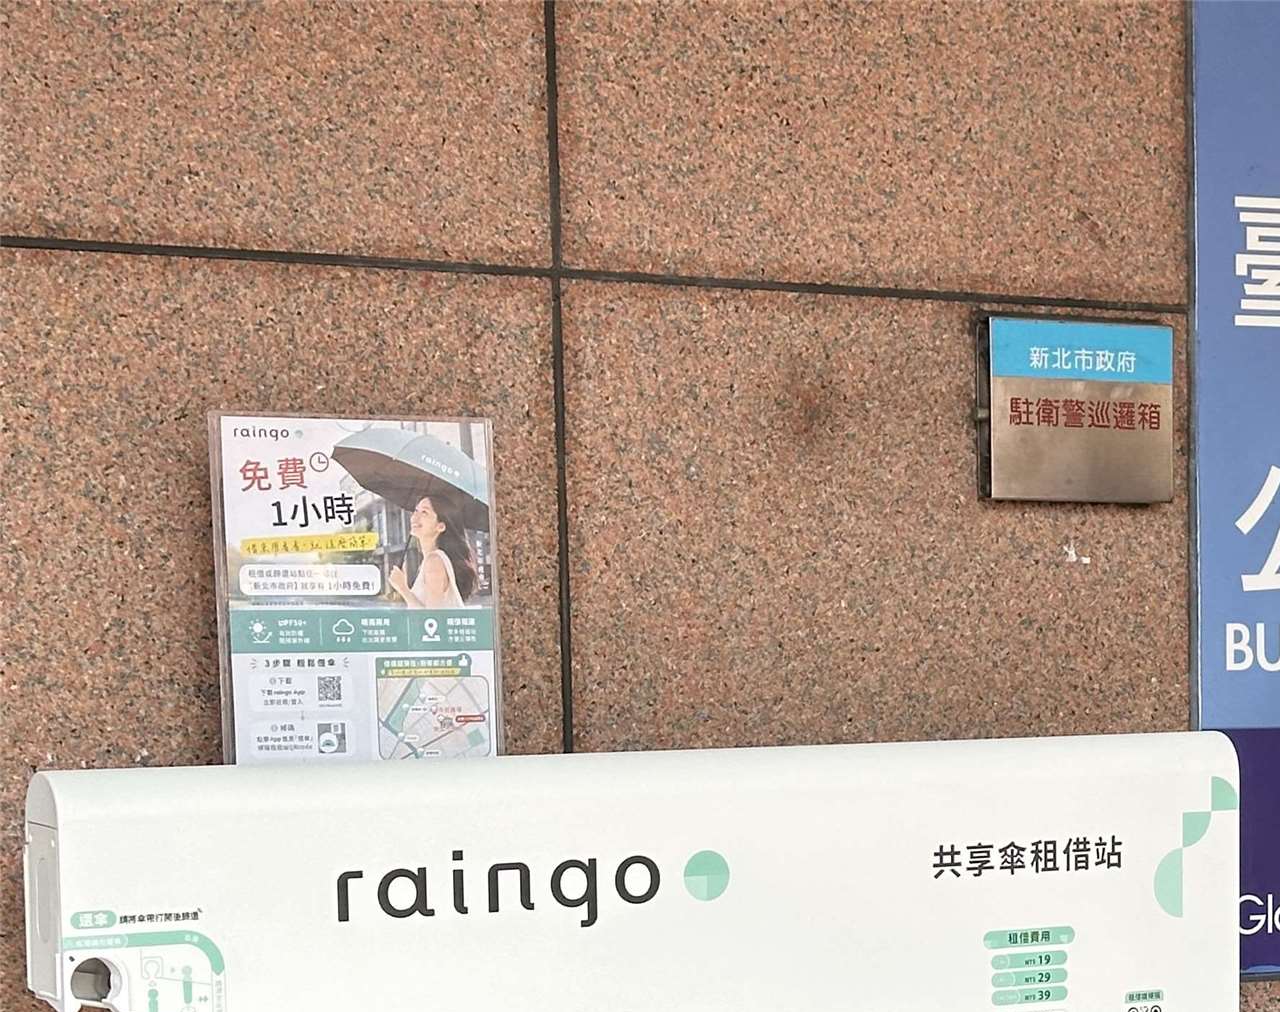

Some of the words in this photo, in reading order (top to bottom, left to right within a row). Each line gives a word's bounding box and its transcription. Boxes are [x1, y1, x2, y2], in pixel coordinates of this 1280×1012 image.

[1029, 347, 1136, 373] 新北市政府
[1009, 397, 1161, 431] 駐衛警巡邏箱
[233, 426, 290, 441] raingo
[239, 458, 308, 492] 免費
[271, 493, 354, 528] 1小時
[932, 835, 1123, 879] 共享傘租借站
[337, 850, 661, 928] raingo
[1008, 931, 1051, 945] 租借費用
[1038, 955, 1051, 965] 19
[1038, 972, 1051, 982] 29
[1038, 990, 1051, 1000] 39
